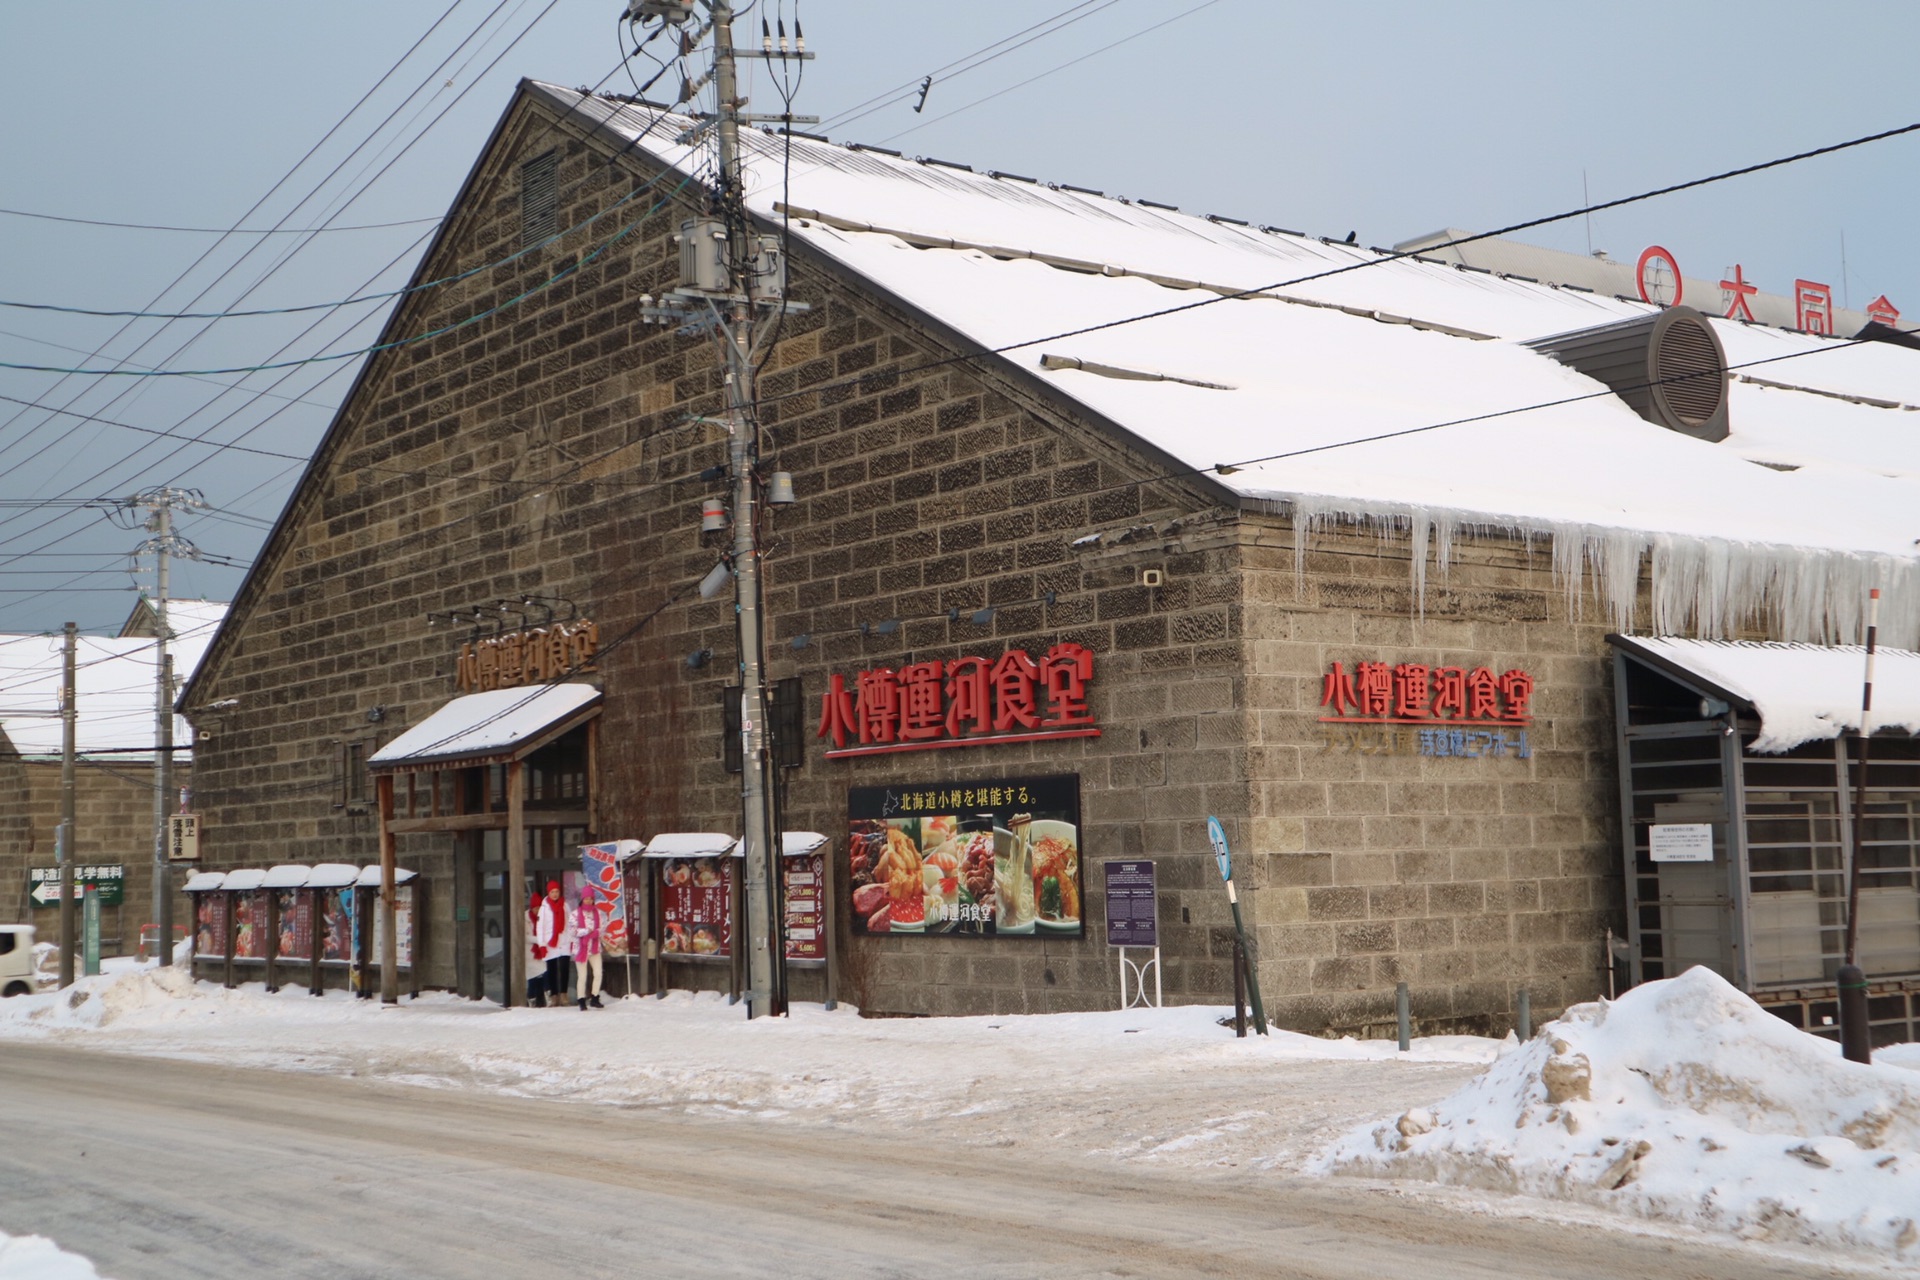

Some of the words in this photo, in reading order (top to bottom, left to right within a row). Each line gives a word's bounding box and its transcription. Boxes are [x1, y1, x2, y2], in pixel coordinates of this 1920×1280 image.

[455, 618, 599, 693] 小樽運河食堂
[817, 643, 1095, 748] 小樽運河食堂
[1320, 660, 1534, 720] 小樽運河食堂
[1419, 729, 1532, 758] 浅草橋ビアホール
[900, 786, 1036, 811] 北海道小樽を堪能する。
[185, 818, 195, 837] 頭上
[31, 866, 122, 881] 醸造見学無料
[722, 878, 731, 944] ラーメン
[815, 876, 824, 936] バイキング
[929, 902, 992, 922] 小樽運河食堂
